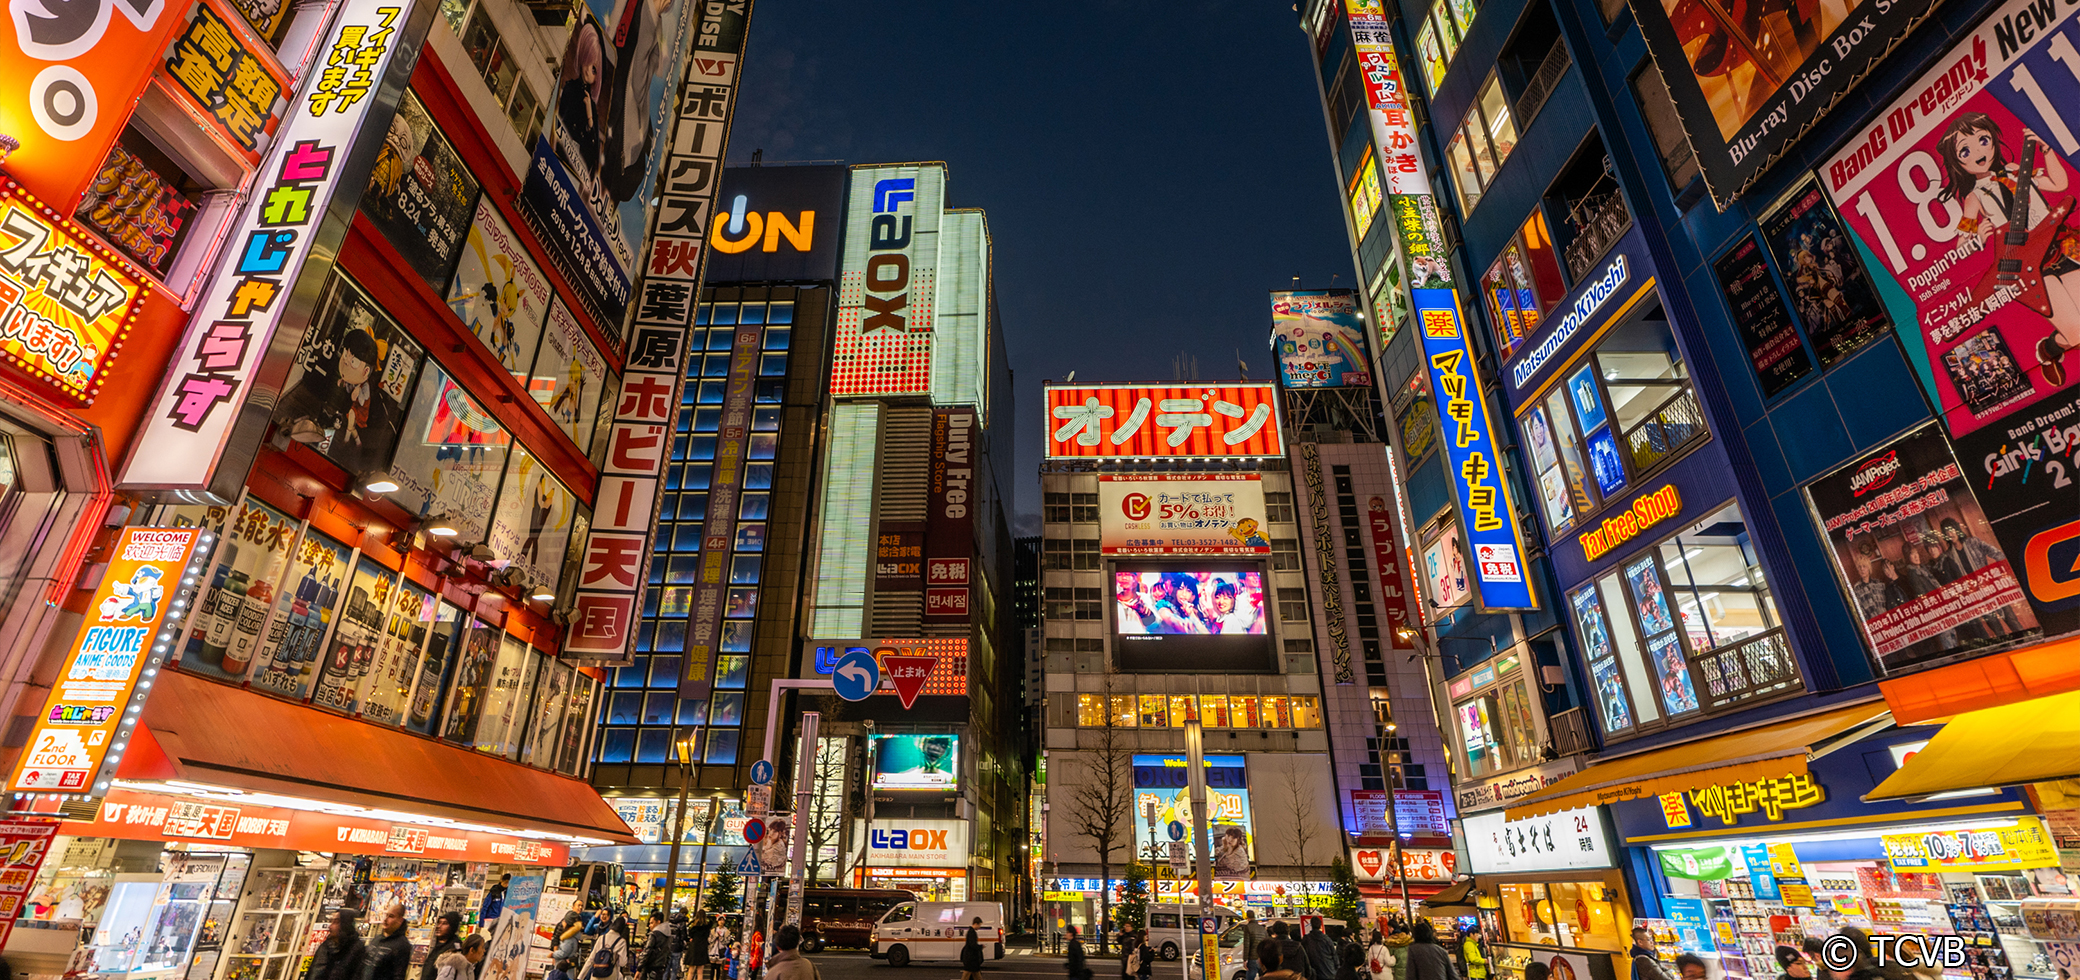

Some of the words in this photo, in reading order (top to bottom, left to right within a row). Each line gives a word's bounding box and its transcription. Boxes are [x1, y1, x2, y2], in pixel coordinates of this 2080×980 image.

[1354, 30, 1391, 44] 麻雀
[335, 7, 402, 113] フィギュア
[308, 25, 369, 117] 買います
[1726, 107, 1789, 167] Blu-ray
[1787, 58, 1832, 105] Disc
[1830, 16, 1877, 62] Box
[1380, 109, 1418, 174] 耳かき
[1828, 124, 1889, 194] BanG
[1382, 145, 1403, 195] もみほぐし
[397, 193, 422, 225] 8.24
[0, 208, 127, 324] フィギュア
[1908, 234, 1985, 292] Poppin'Party
[167, 139, 336, 432] とれじゃらす
[1933, 276, 1952, 296] Single
[1423, 311, 1458, 337] 薬
[738, 332, 758, 343] 6F
[1514, 316, 1578, 391] Matsumoto
[1054, 386, 1271, 447] オノデン
[723, 428, 745, 439] 5F
[936, 413, 947, 459] Flagship
[945, 413, 973, 464] Duty
[1432, 348, 1503, 532] マツモトキヨシ
[934, 459, 945, 494] Store
[945, 467, 972, 519] Free
[1159, 493, 1234, 504] カードで払って
[1159, 504, 1200, 520] 5%
[1124, 522, 1151, 530] CASHLESS
[1579, 527, 1606, 563] Tax
[1602, 511, 1637, 550] Free
[1633, 484, 1682, 530] Shop
[132, 531, 191, 544] WELCOME
[706, 537, 729, 550] 4F
[879, 534, 901, 546] 本店
[878, 546, 922, 558] 総合家電
[930, 562, 967, 581] 免税
[1428, 552, 1438, 579] 2F
[1484, 562, 1514, 576] 免税
[1440, 574, 1451, 602] 3F
[928, 594, 967, 610] 면세점
[82, 628, 149, 653] FIGURE
[74, 653, 106, 668] ANIME
[104, 654, 136, 668] GOODS
[893, 666, 928, 679] 止まれ
[49, 704, 116, 721] とれじゃらす
[39, 735, 68, 753] 2nd
[32, 754, 77, 767] FLOOR
[66, 772, 81, 780] TAX
[1136, 768, 1244, 787] ONOEN
[1690, 771, 1825, 825] マツモトキヨシ
[236, 815, 269, 835] HOBBY
[267, 820, 290, 837] 天国
[1574, 815, 1589, 833] 24
[348, 828, 388, 845] AKIHABARA
[1578, 836, 1595, 853] 時間
[2001, 827, 2046, 846] 松本清
[870, 852, 908, 860] AKIHABARA
[908, 852, 925, 860] MAIN
[926, 853, 948, 861] STORE
[1895, 859, 1907, 867] TAX
[1906, 858, 1923, 867] FREE
